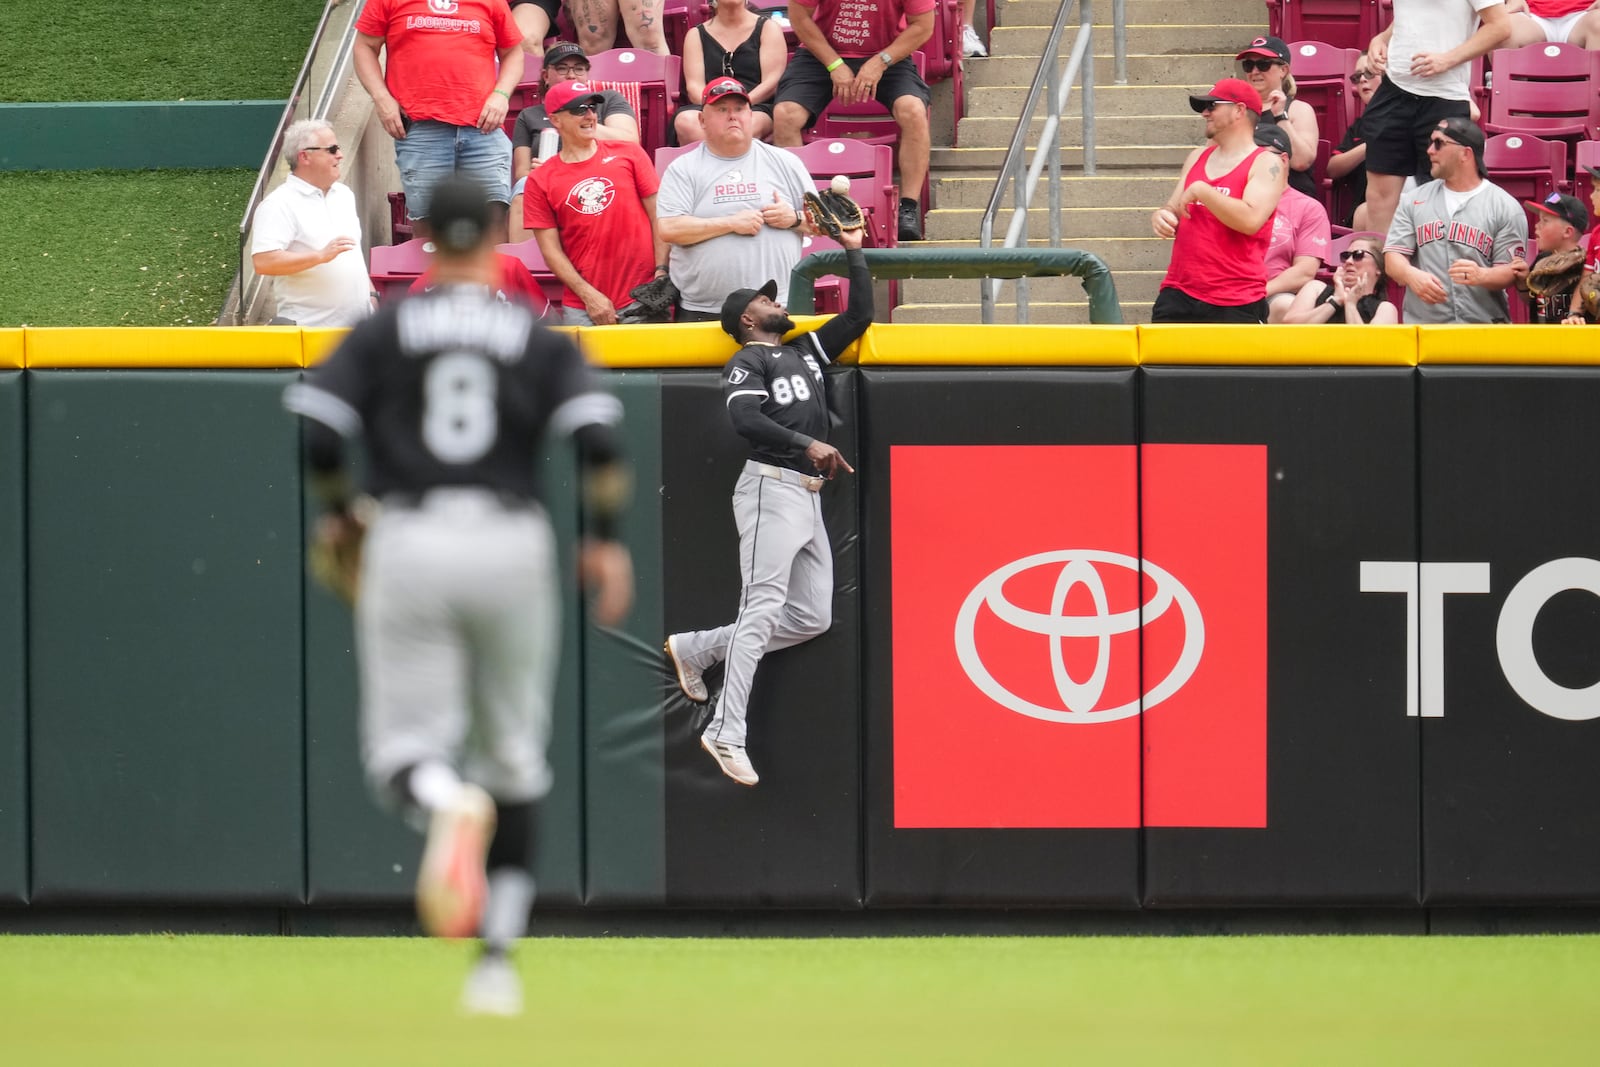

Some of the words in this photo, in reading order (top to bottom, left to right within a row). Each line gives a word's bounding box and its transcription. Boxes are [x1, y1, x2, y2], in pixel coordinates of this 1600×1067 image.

[861, 20, 869, 28] &
[862, 29, 870, 37] &
[715, 183, 757, 196] REDS
[772, 374, 811, 406] 88
[423, 351, 498, 464] 8
[1359, 556, 1600, 721] TO
